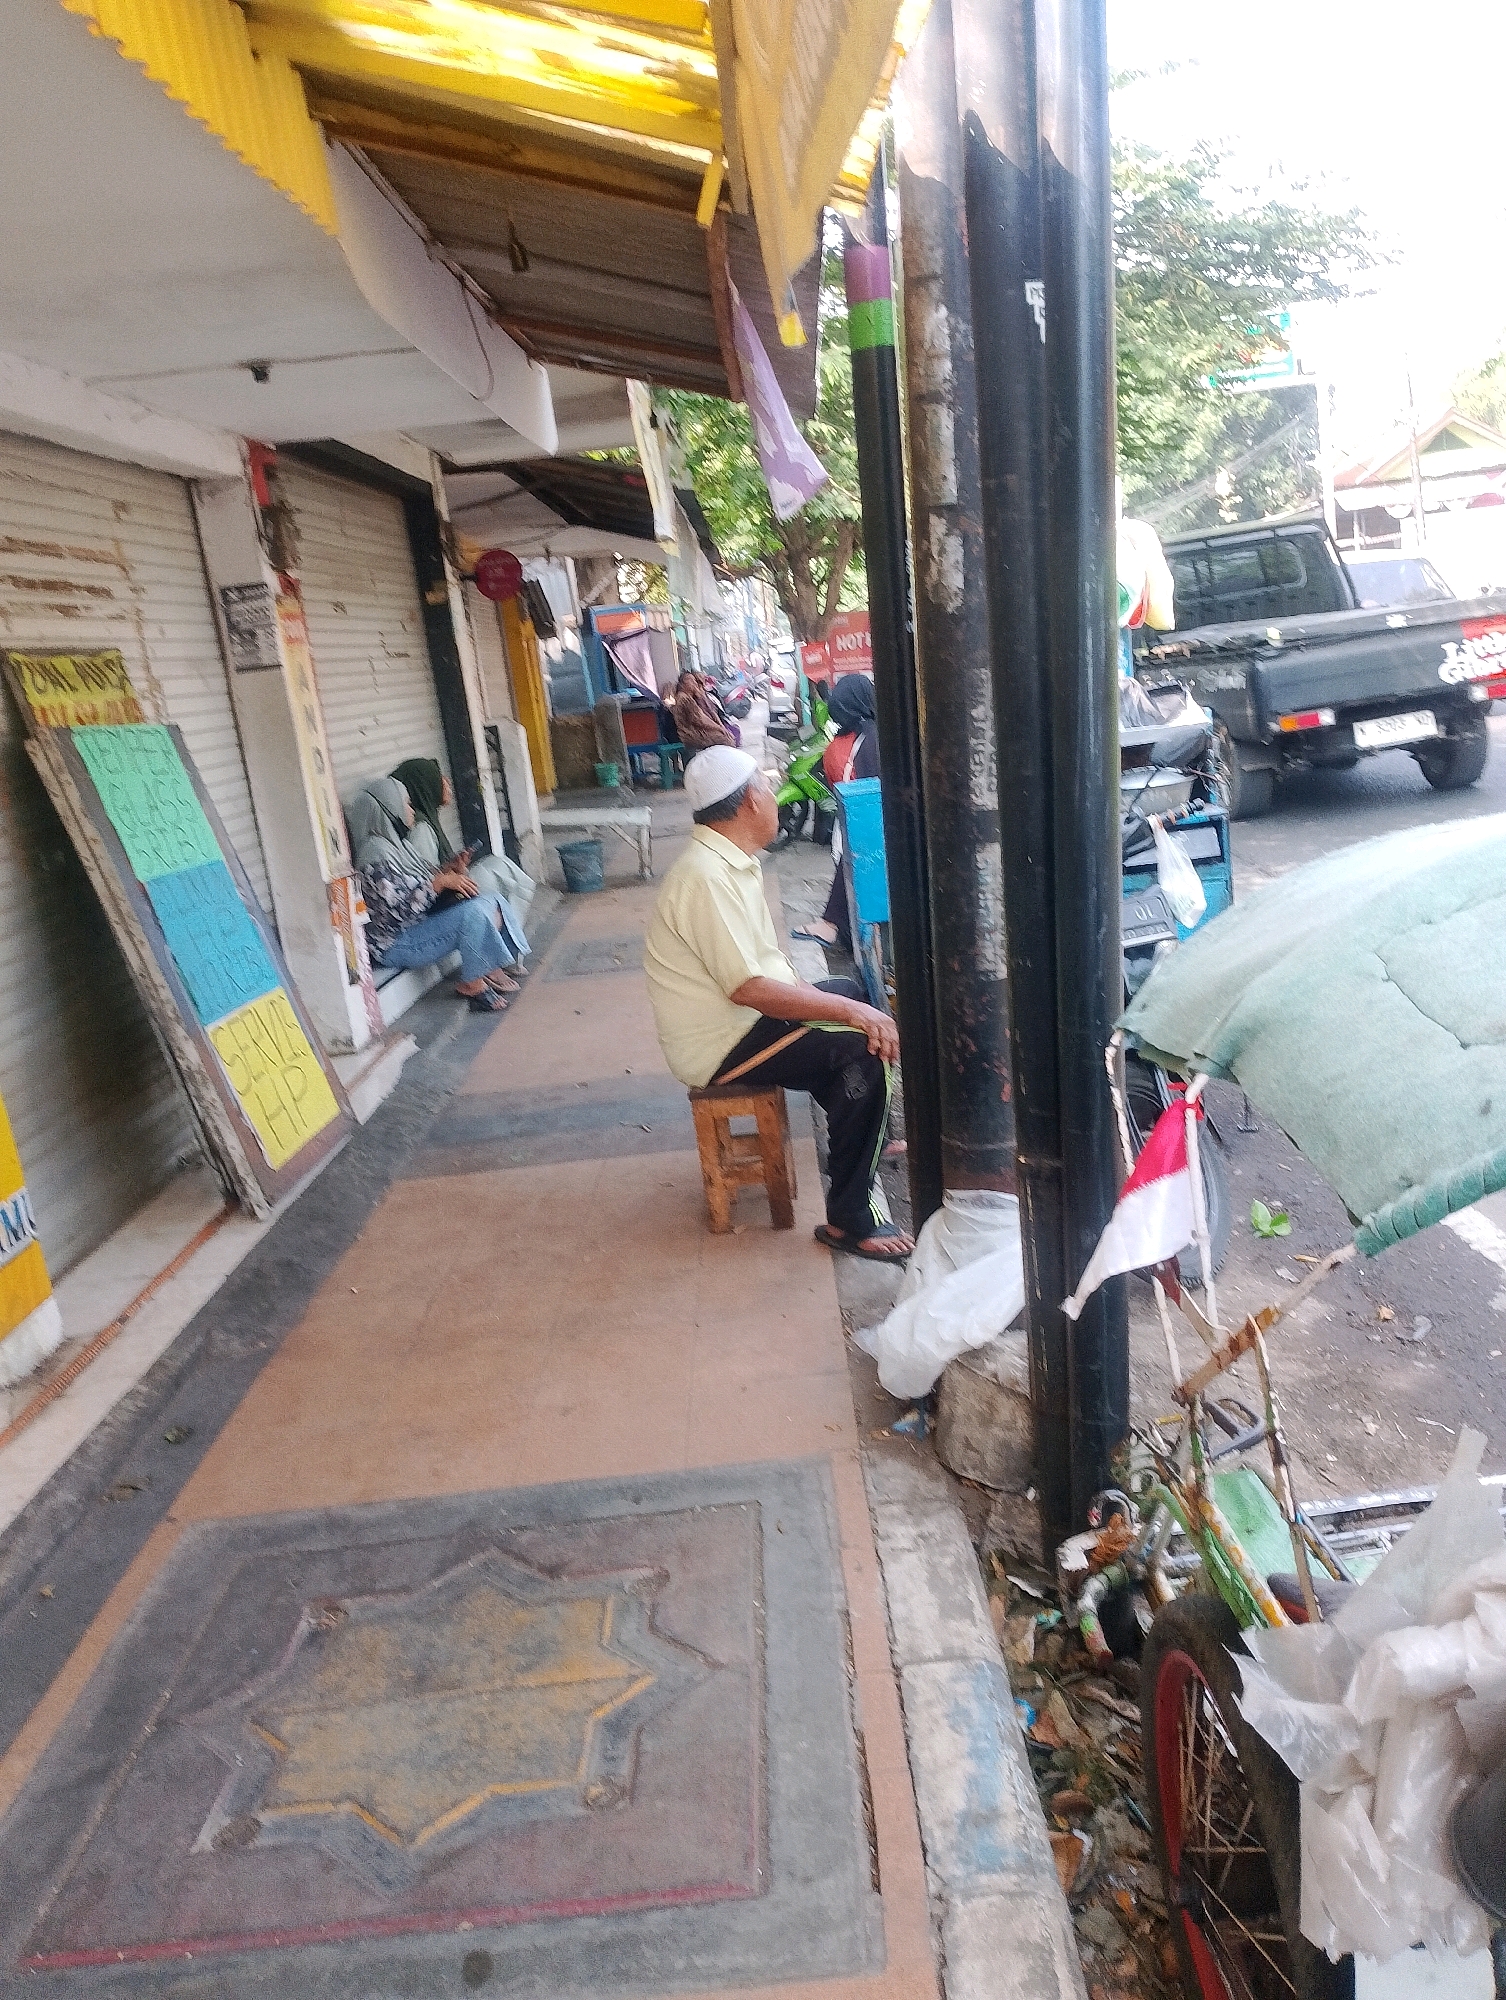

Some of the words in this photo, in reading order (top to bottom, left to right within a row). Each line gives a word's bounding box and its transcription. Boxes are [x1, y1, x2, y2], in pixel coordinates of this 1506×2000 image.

[108, 777, 199, 834] GLASS
[209, 994, 307, 1096] SERVIS
[254, 1064, 308, 1150] HP
